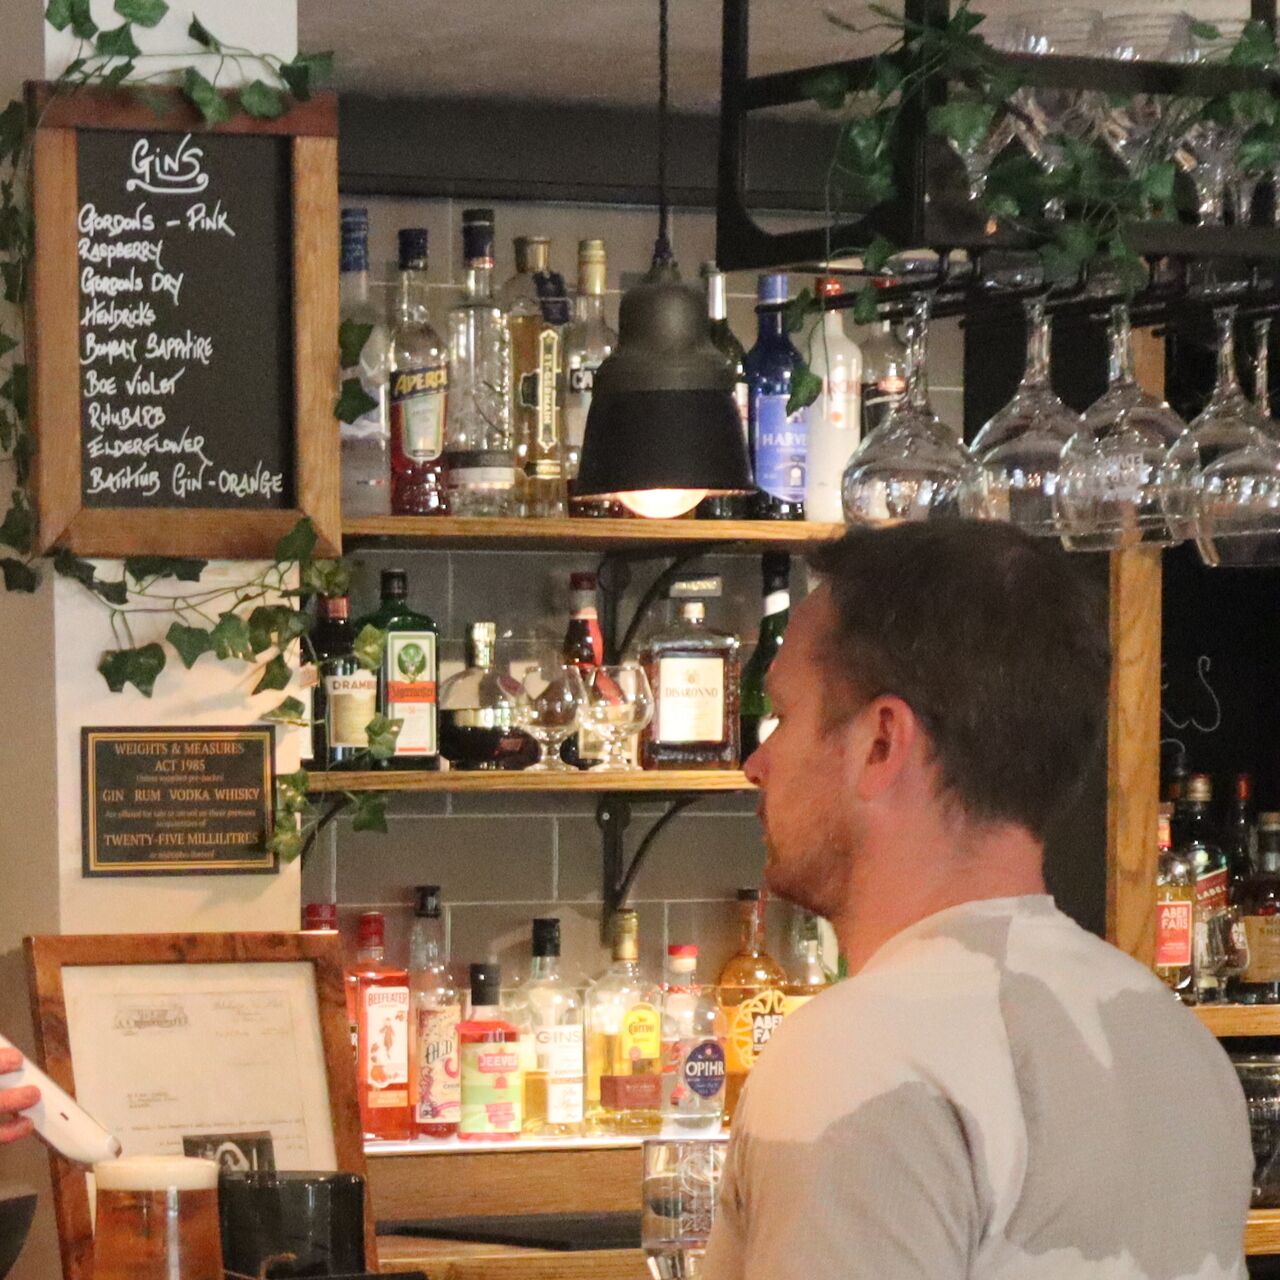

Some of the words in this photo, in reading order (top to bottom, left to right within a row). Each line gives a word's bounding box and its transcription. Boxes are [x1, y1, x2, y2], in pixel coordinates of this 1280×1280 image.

[151, 272, 184, 306] DRY
[80, 332, 137, 364] BOMBAY
[84, 369, 117, 397] BOE
[89, 402, 166, 432] RHUBARB
[87, 425, 214, 466] ELDERFLOWER
[87, 462, 160, 496] BATHTUB
[218, 460, 283, 498] ORANGE
[114, 743, 167, 755] WEIGHTS
[171, 744, 181, 754] &
[184, 742, 245, 754] MEASURES
[155, 759, 177, 772] ACT
[181, 759, 206, 771] 1985
[102, 789, 124, 801] GIN
[134, 789, 161, 801] RUM
[169, 788, 211, 800] VODKA
[215, 788, 260, 800] WHISKY
[368, 992, 408, 1006] BEEFEATER
[685, 1060, 725, 1077] OPIHR
